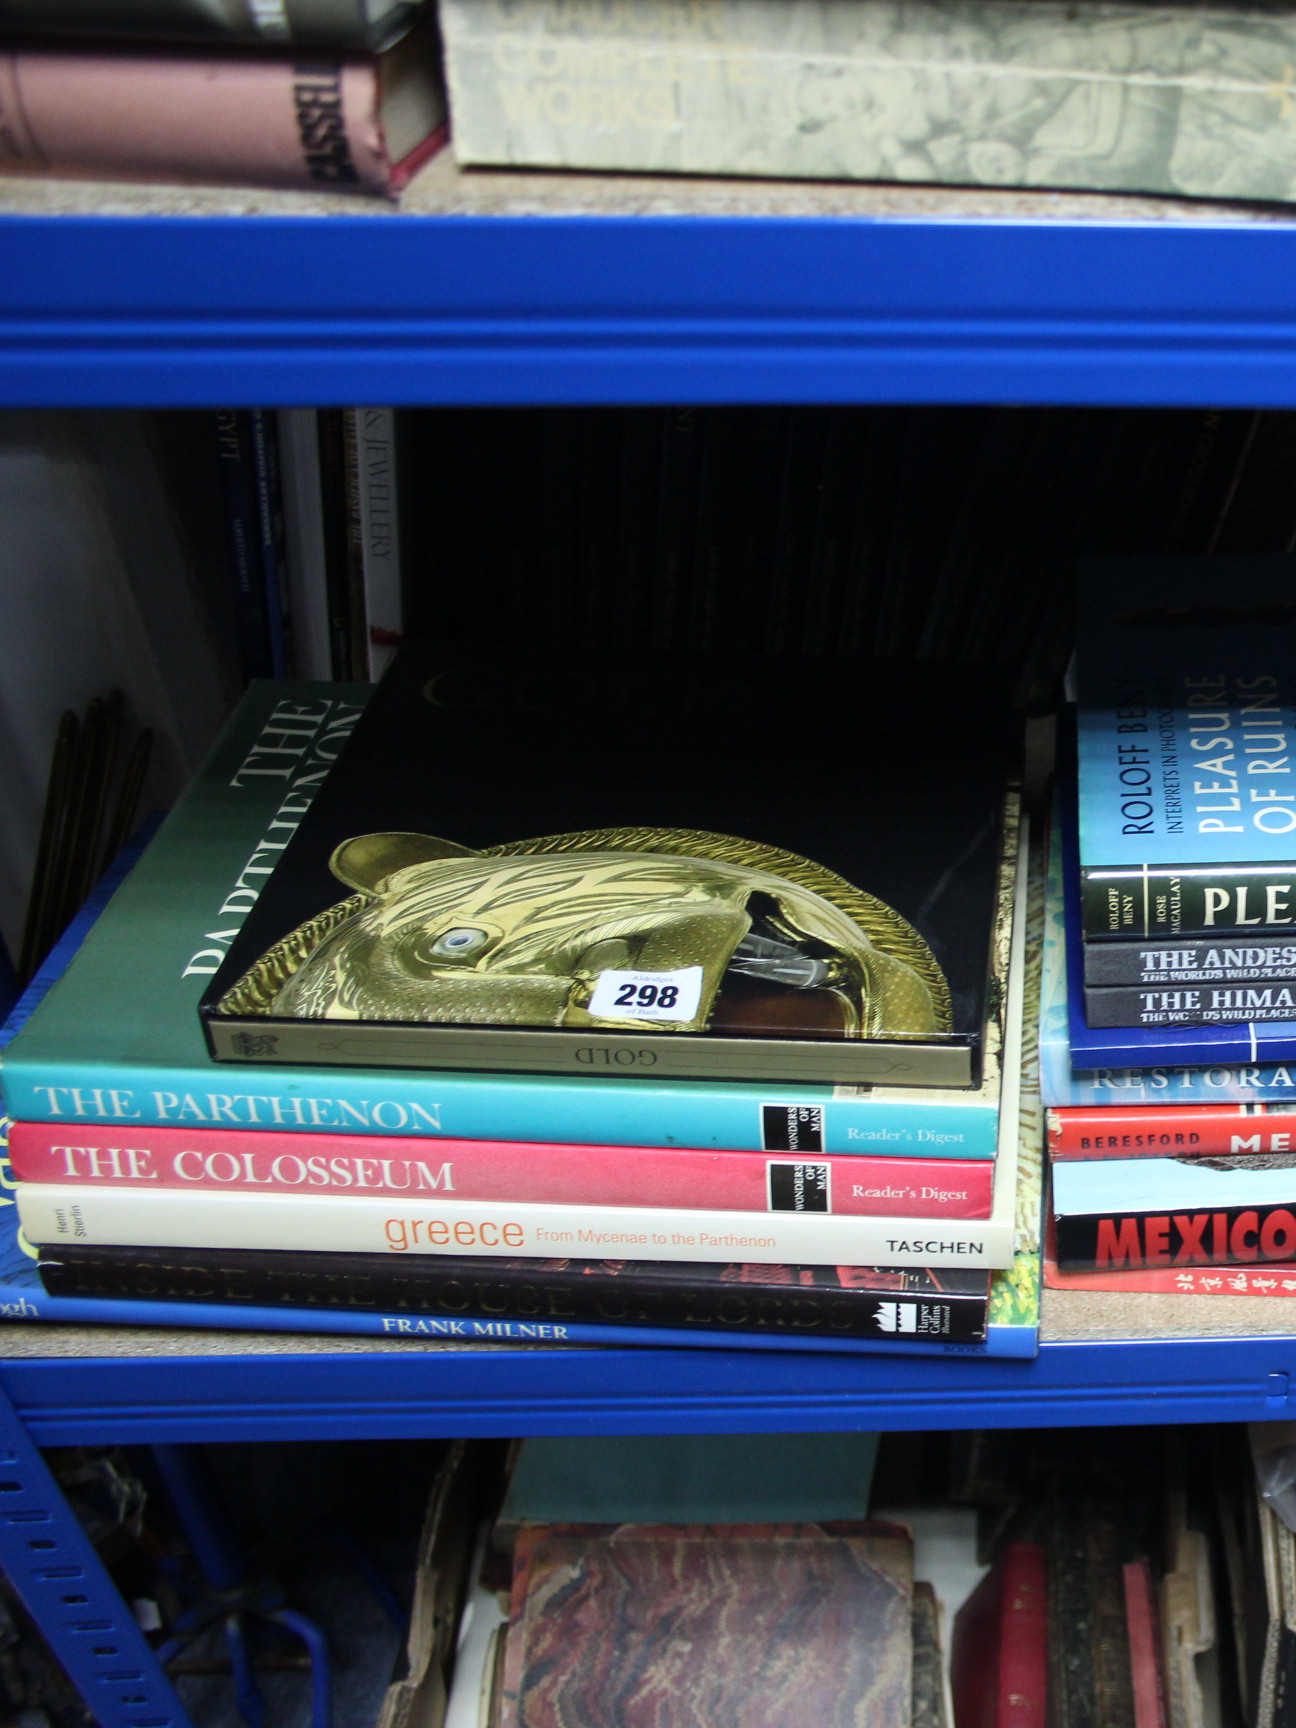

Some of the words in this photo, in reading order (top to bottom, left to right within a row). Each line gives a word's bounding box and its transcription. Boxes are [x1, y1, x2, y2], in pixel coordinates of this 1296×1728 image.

[362, 436, 393, 563] JEWELLERY
[1115, 677, 1149, 734] BENY
[1234, 675, 1292, 774] RUINS
[229, 699, 334, 787] THE
[1184, 674, 1245, 834] PLEASURE
[1160, 753, 1178, 767] IN
[1116, 744, 1155, 836] ROLOFF
[1161, 769, 1184, 834] INTERPRETS
[1109, 887, 1119, 931] ROLOFF
[1123, 893, 1134, 925] BENY
[1156, 895, 1167, 923] ROSE
[1171, 877, 1181, 935] MACAULAY
[1140, 949, 1198, 971] THE
[613, 983, 679, 1008] 298
[1140, 991, 1202, 1011] THE
[574, 1047, 658, 1067] GOLD
[33, 1086, 142, 1118] THE
[151, 1091, 443, 1131] PARTHENON
[799, 1107, 810, 1122] OF
[811, 1108, 821, 1132] MAN
[787, 1106, 799, 1151] WONDERS
[847, 1127, 913, 1140] Reader's
[917, 1129, 965, 1144] Digest
[1081, 1132, 1200, 1149] BERESFORD
[51, 1146, 158, 1179] THE
[172, 1150, 457, 1191] COLOSSEUM
[805, 1165, 816, 1180] OF
[816, 1166, 827, 1190] MAN
[794, 1165, 804, 1211] WONDERS
[852, 1184, 916, 1198] Reader's
[920, 1186, 968, 1203] Digest
[55, 1206, 70, 1234] Henri
[384, 1217, 525, 1251] greece
[535, 1227, 574, 1243] From
[577, 1228, 648, 1245] Mycenae
[651, 1233, 668, 1245] to
[671, 1233, 696, 1246] the
[699, 1232, 777, 1249] Parthenon
[886, 1239, 984, 1255] TASCHEN
[267, 1269, 376, 1306] THE
[390, 1277, 576, 1317] HOUSE
[381, 1318, 467, 1336] FRANK
[471, 1321, 569, 1340] MILNER
[917, 1303, 931, 1333] Harper
[930, 1304, 941, 1334] Collins
